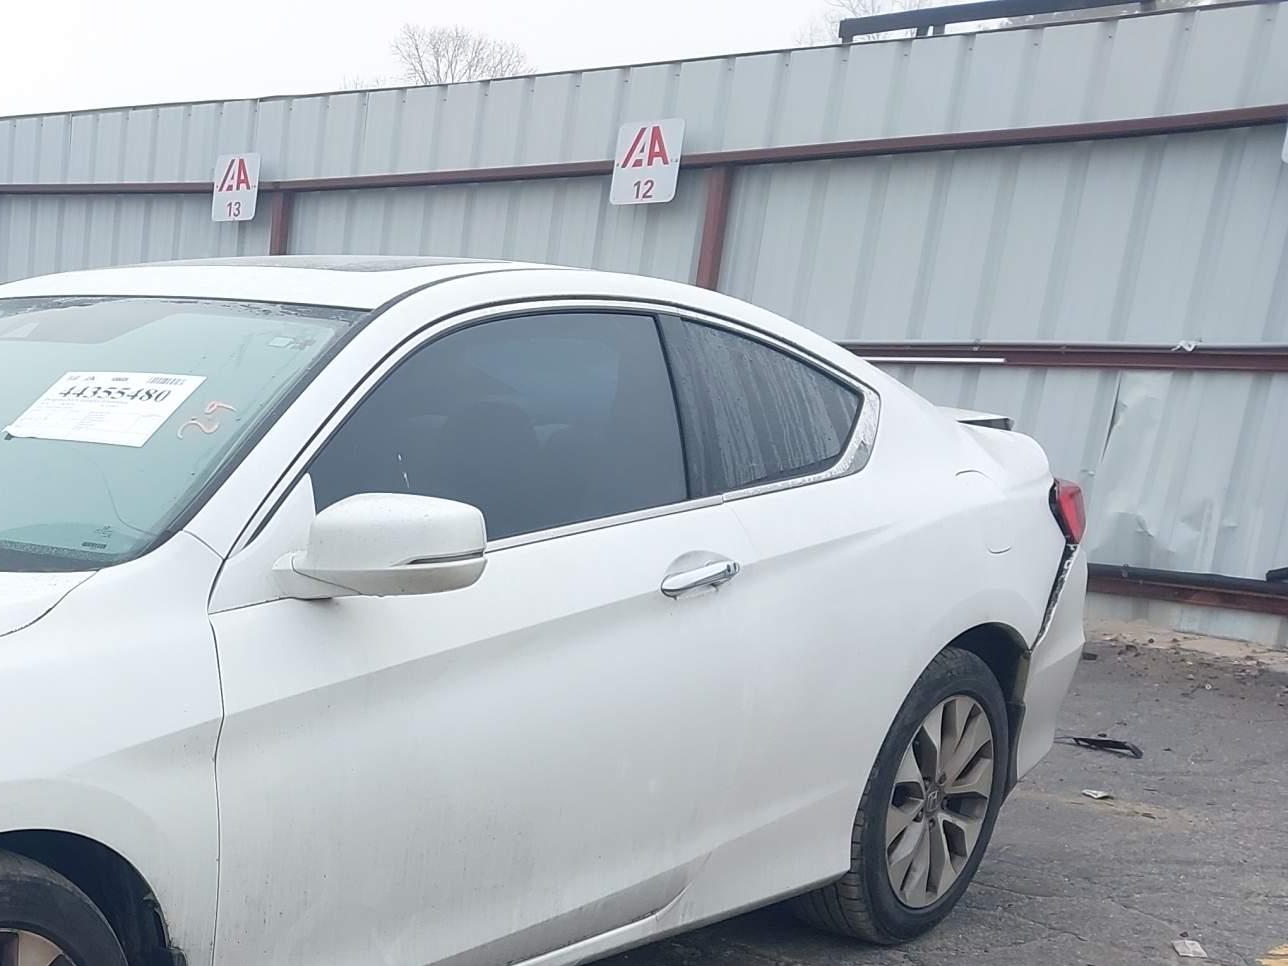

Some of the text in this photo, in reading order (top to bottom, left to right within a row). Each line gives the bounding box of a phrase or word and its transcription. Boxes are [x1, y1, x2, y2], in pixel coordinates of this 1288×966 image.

[633, 179, 655, 199] 12
[227, 201, 241, 217] 13
[58, 386, 172, 402] 44355480
